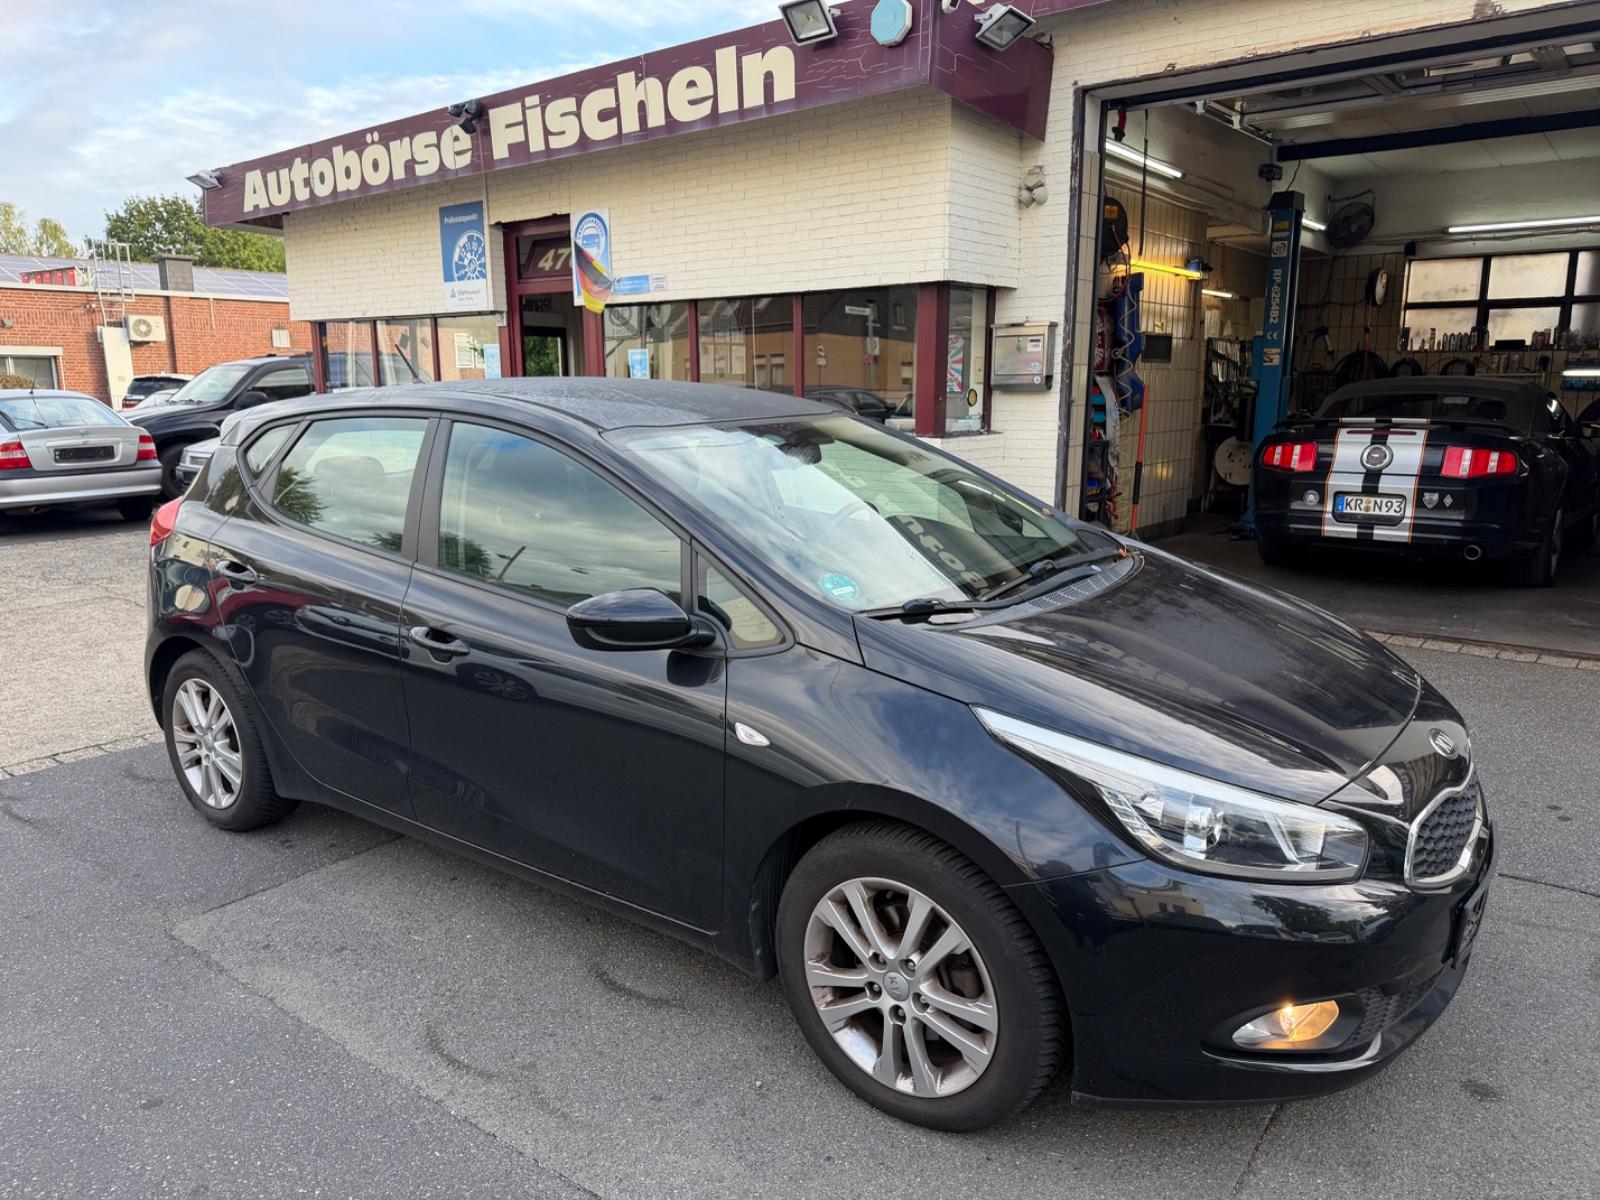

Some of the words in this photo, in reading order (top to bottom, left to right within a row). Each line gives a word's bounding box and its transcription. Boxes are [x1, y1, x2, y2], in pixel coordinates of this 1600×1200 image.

[243, 125, 473, 213] Autobörse
[488, 45, 796, 160] Fischeln
[538, 247, 572, 271] 47
[1344, 498, 1363, 512] KR
